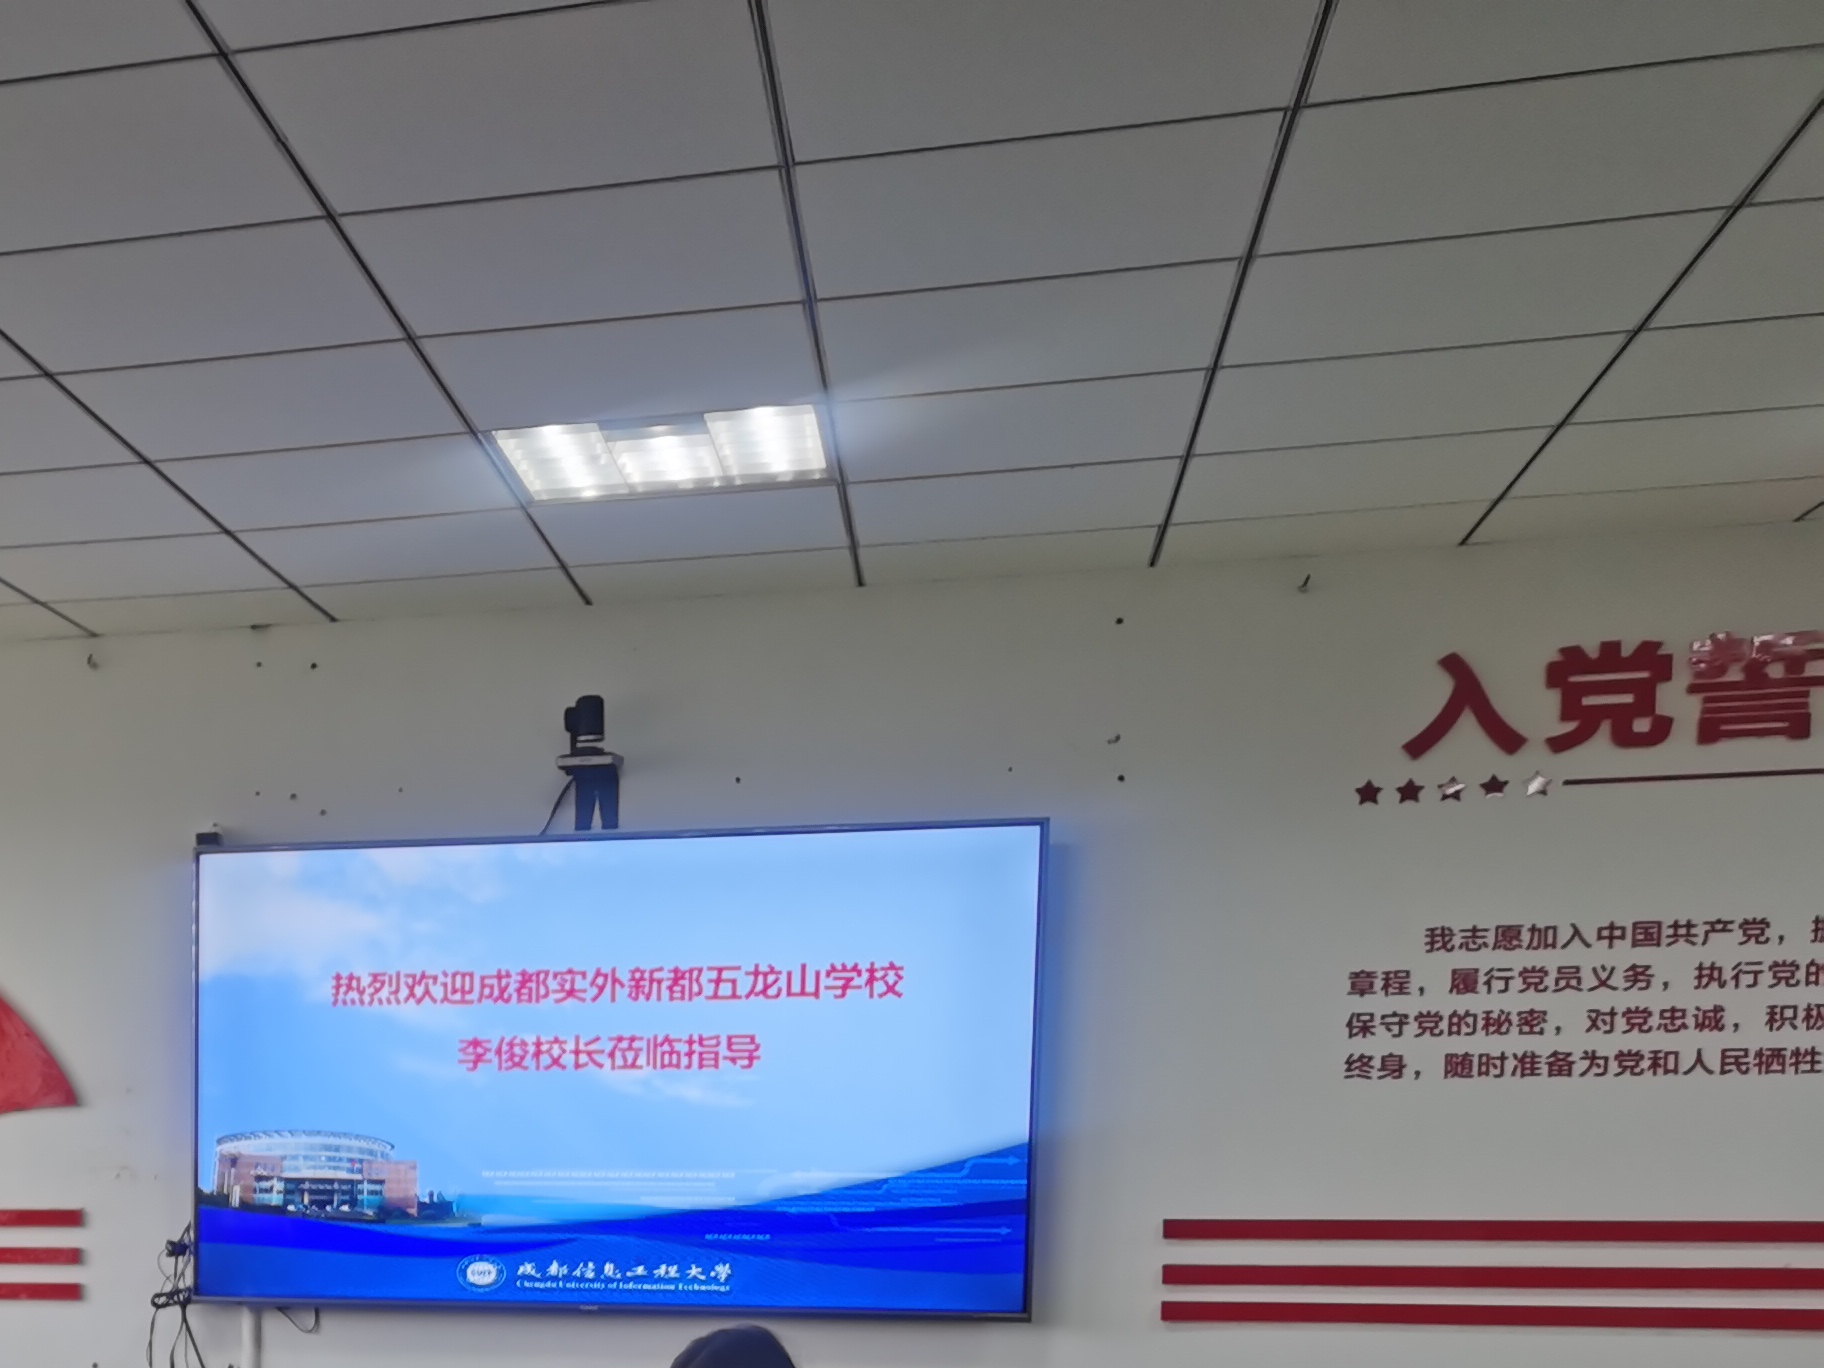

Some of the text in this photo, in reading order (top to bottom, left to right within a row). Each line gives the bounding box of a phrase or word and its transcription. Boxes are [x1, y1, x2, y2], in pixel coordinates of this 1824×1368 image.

[330, 960, 905, 1008] 热烈欢迎成都实外新都五龙山学校
[457, 1032, 762, 1073] 李俊校长莅临指导
